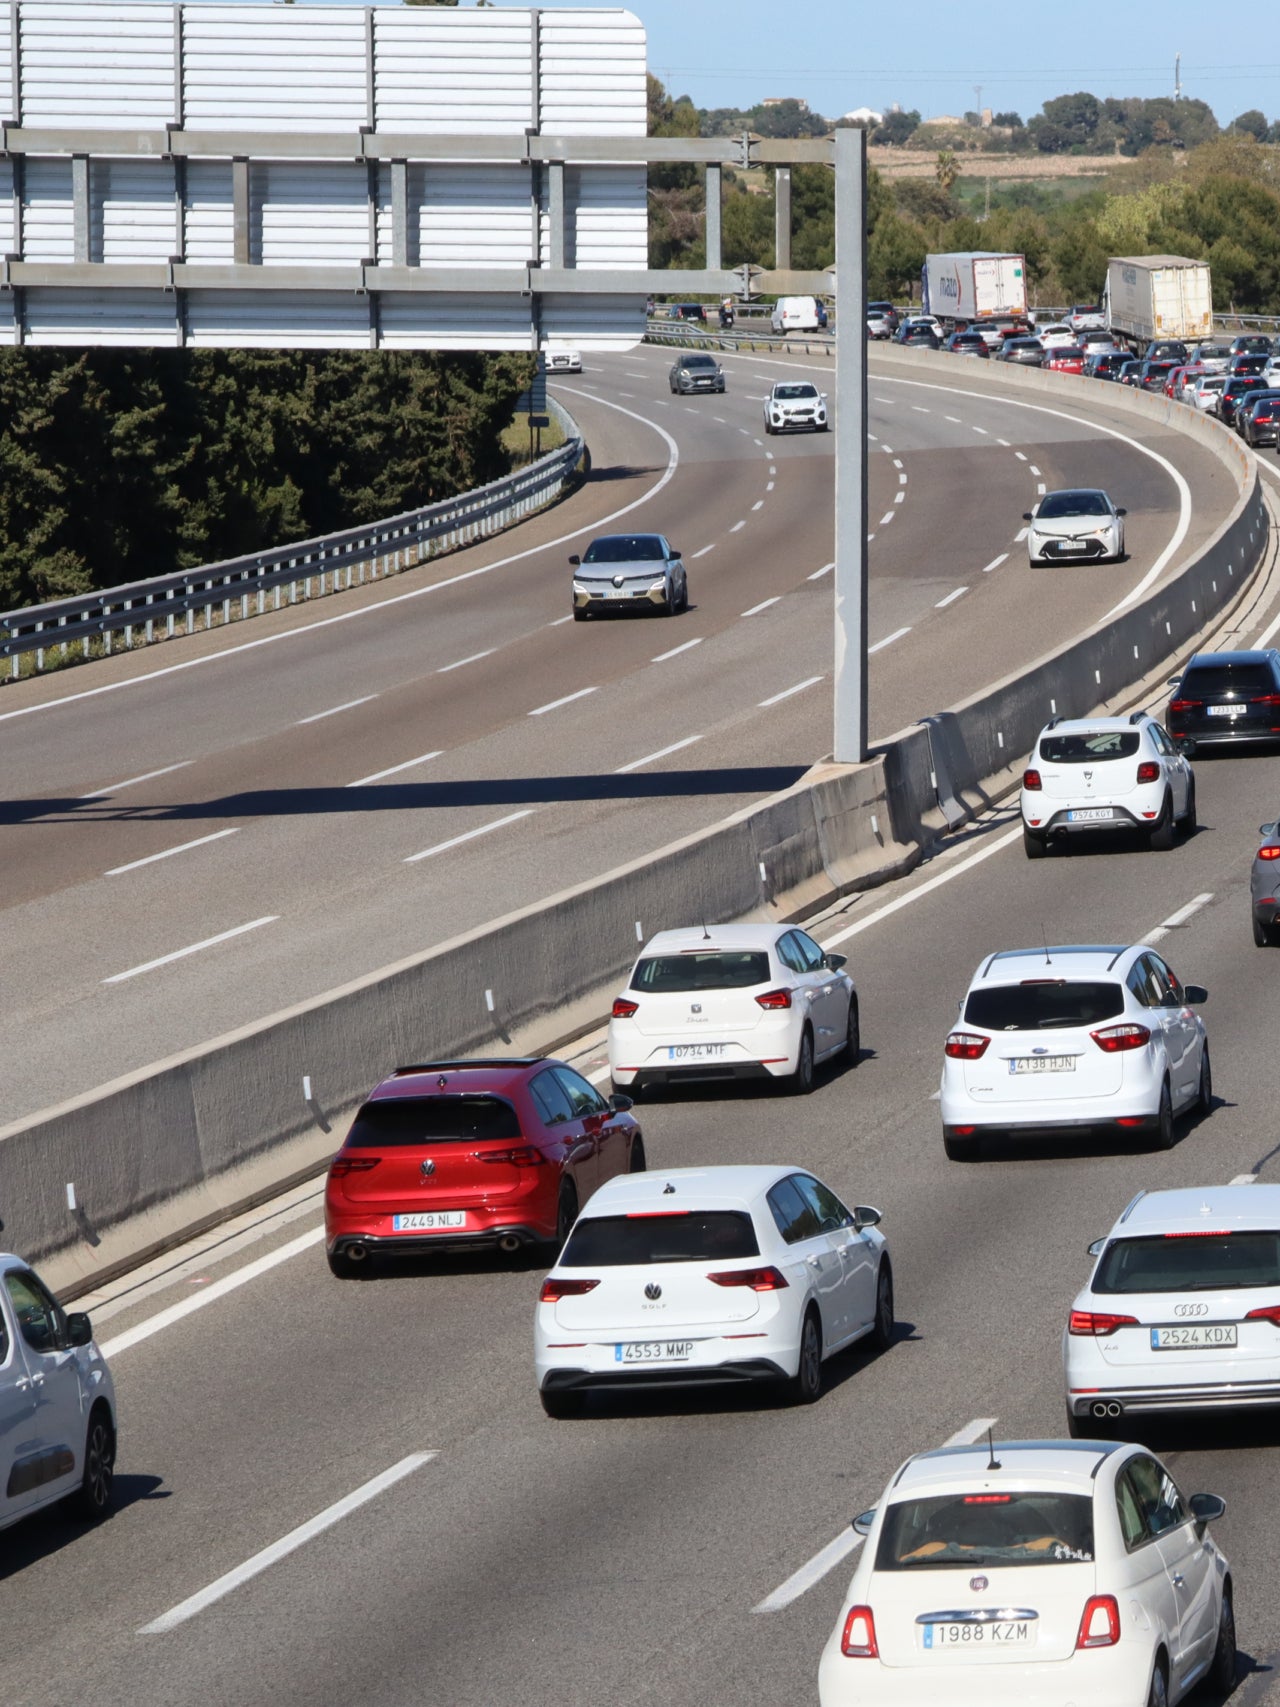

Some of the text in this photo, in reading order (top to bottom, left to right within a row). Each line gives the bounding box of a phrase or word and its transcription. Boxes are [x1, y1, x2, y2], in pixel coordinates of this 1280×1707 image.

[676, 1046, 703, 1057] 0734
[1017, 1056, 1072, 1069] 4138 HJN
[402, 1213, 463, 1228] 2449 NLJ
[1162, 1327, 1232, 1345] 2524 KDX
[625, 1342, 693, 1359] 4553 MMP
[939, 1623, 1028, 1643] 1988 KZM
